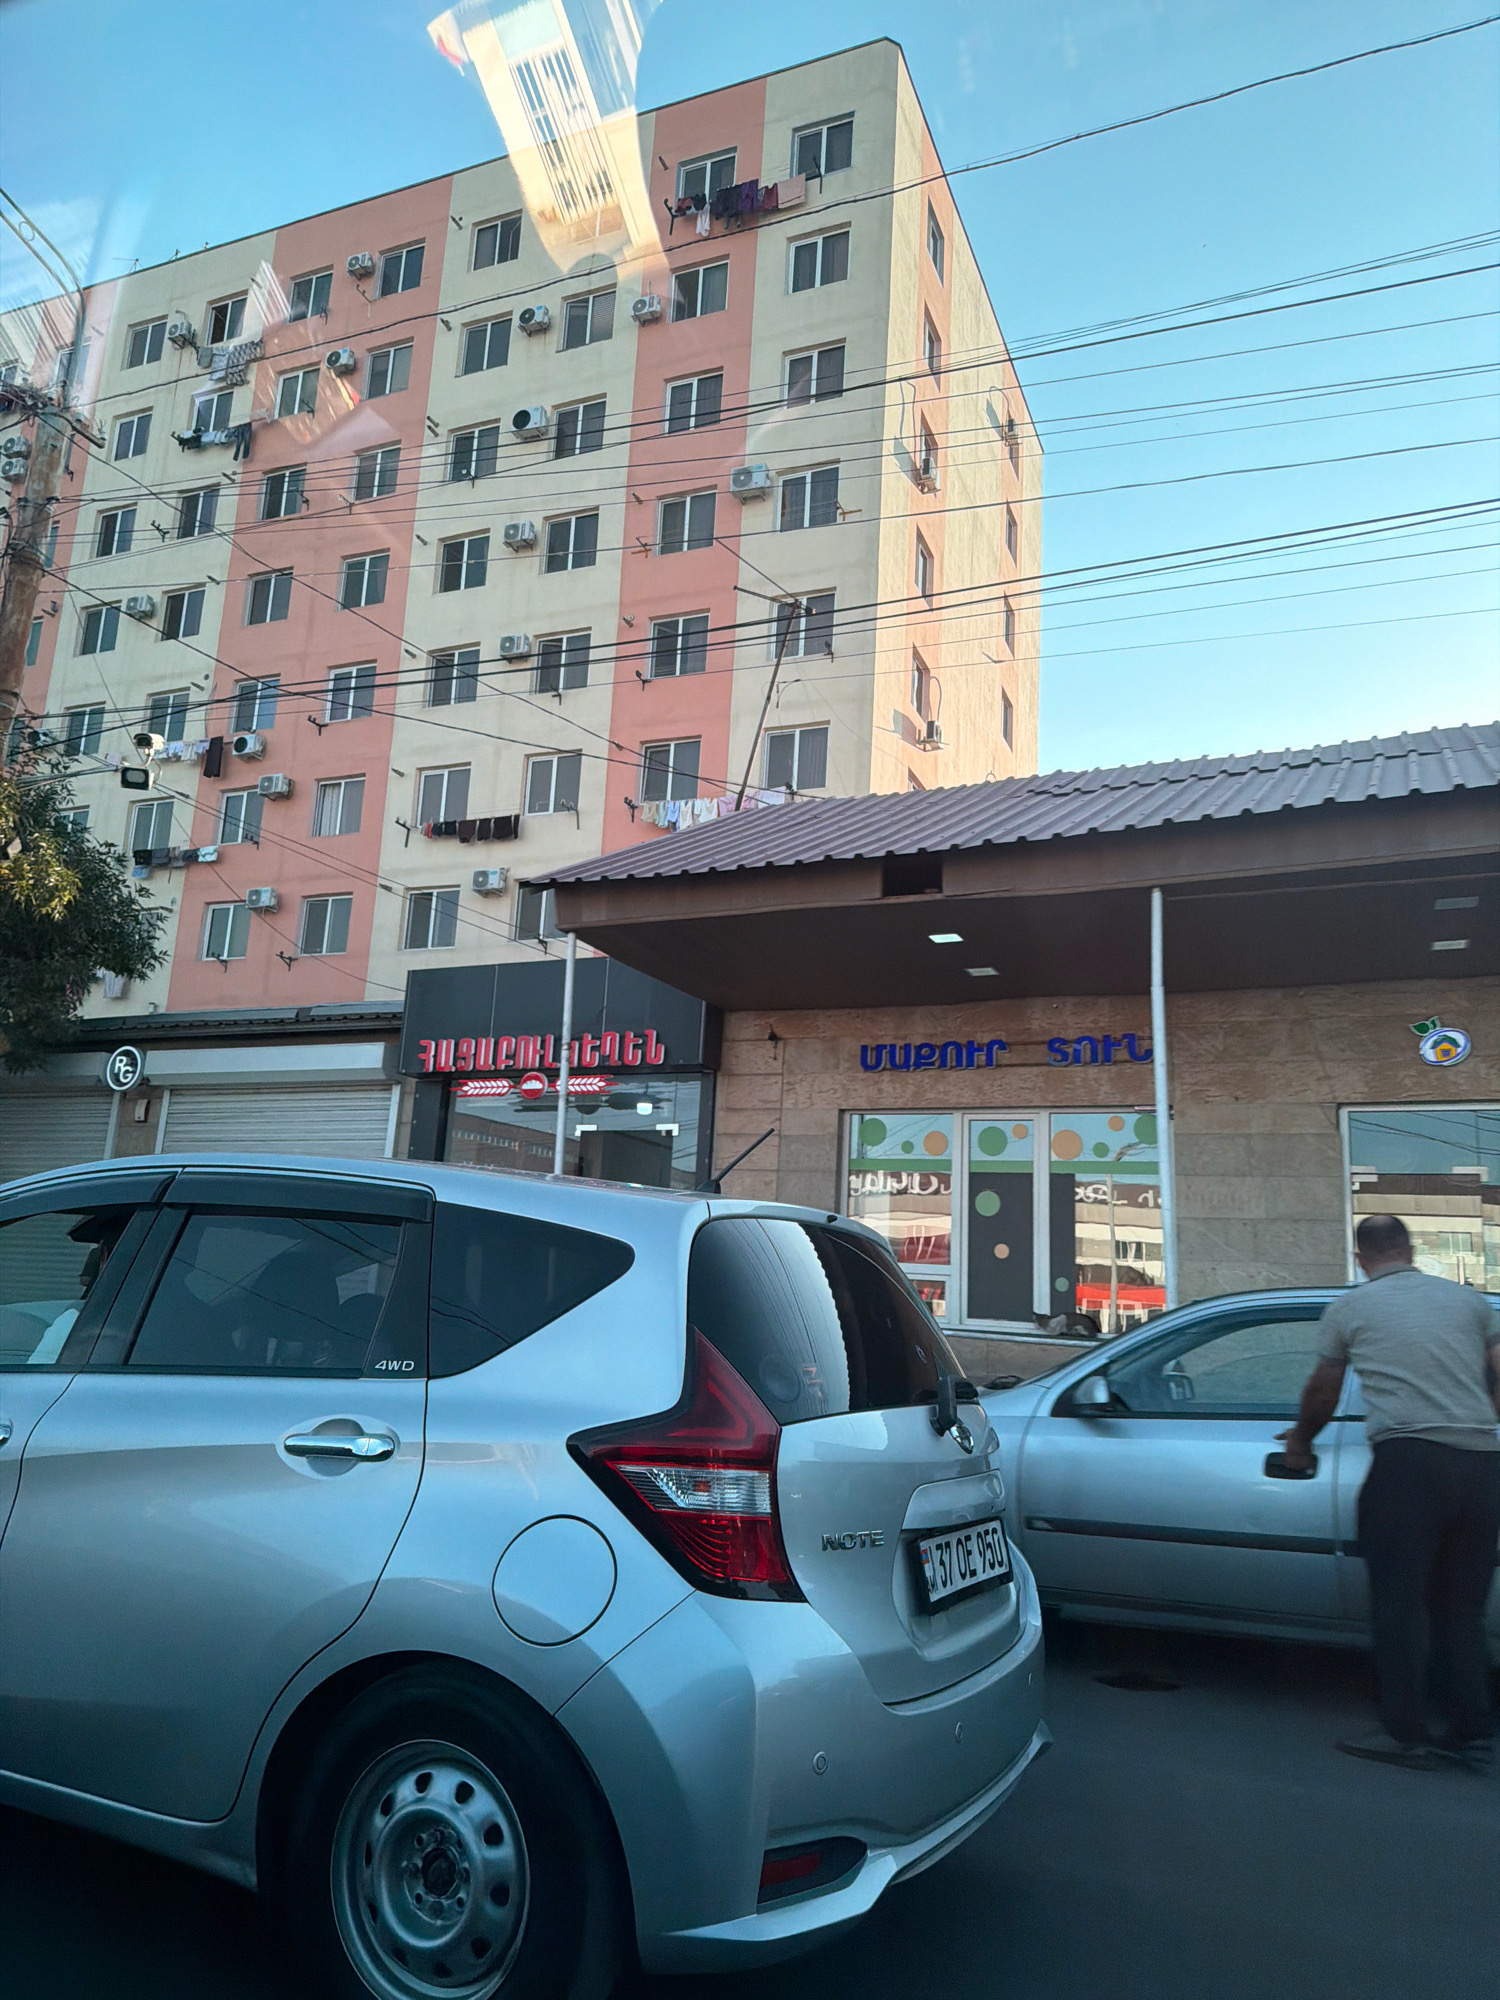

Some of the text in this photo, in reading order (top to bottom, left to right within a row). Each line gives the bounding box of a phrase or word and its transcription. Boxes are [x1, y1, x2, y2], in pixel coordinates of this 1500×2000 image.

[860, 1032, 1154, 1073] ՄԱՔՈՒՐ ՏՈՒՆ
[114, 1055, 134, 1084] RG
[374, 1360, 415, 1371] 4WD
[822, 1530, 885, 1552] NOTE
